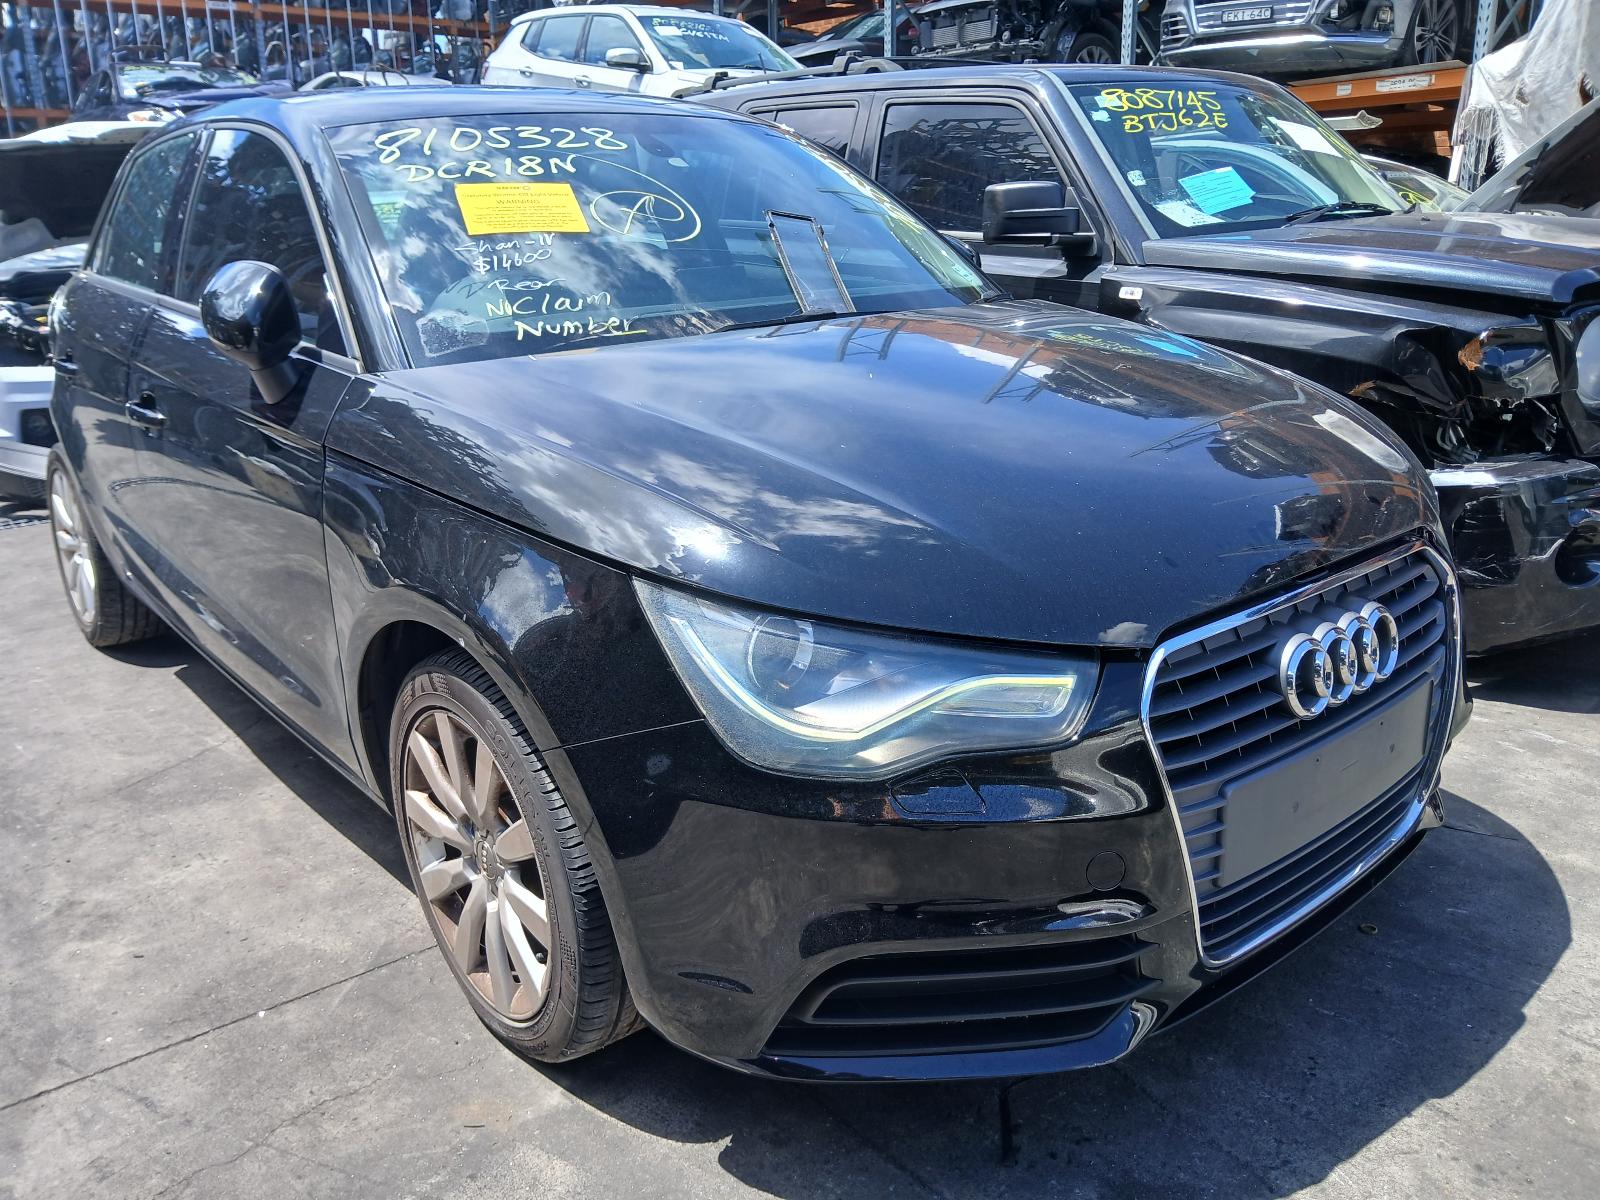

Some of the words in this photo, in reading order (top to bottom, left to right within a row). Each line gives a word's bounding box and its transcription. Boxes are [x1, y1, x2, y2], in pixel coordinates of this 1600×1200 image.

[1101, 88, 1222, 112] 8087145
[1122, 109, 1229, 133] BTJ62E
[374, 126, 629, 164] 8105328
[395, 153, 578, 183] DCR18N
[472, 248, 552, 275] $14600
[512, 291, 611, 315] Claim
[514, 315, 640, 341] Number
